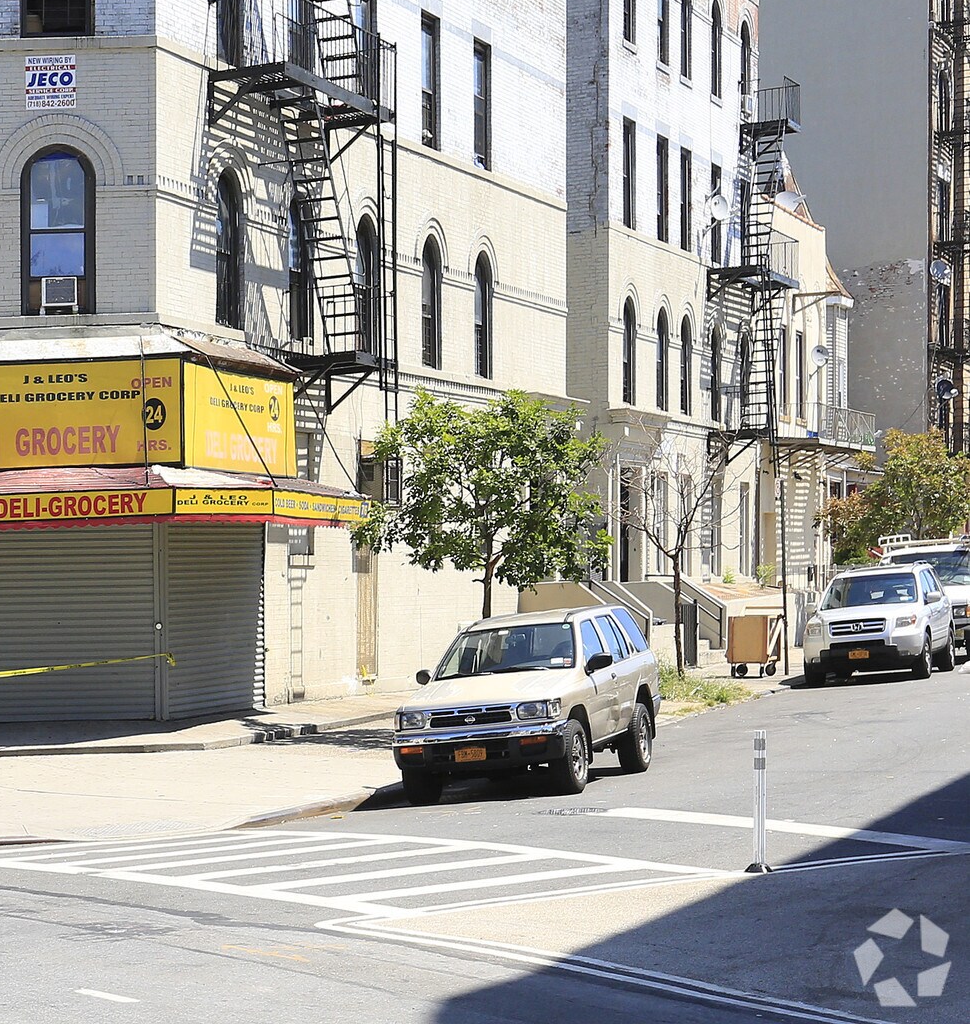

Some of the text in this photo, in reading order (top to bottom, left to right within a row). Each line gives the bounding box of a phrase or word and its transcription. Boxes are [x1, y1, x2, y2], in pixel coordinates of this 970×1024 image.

[27, 71, 73, 87] JECO
[23, 373, 88, 384] J & LEO'S
[131, 376, 172, 389] OPEN
[24, 391, 95, 402] GROCERY
[98, 390, 141, 400] CORP
[145, 405, 163, 424] 24
[15, 425, 121, 456] GROCERY
[137, 440, 172, 452] HRS.
